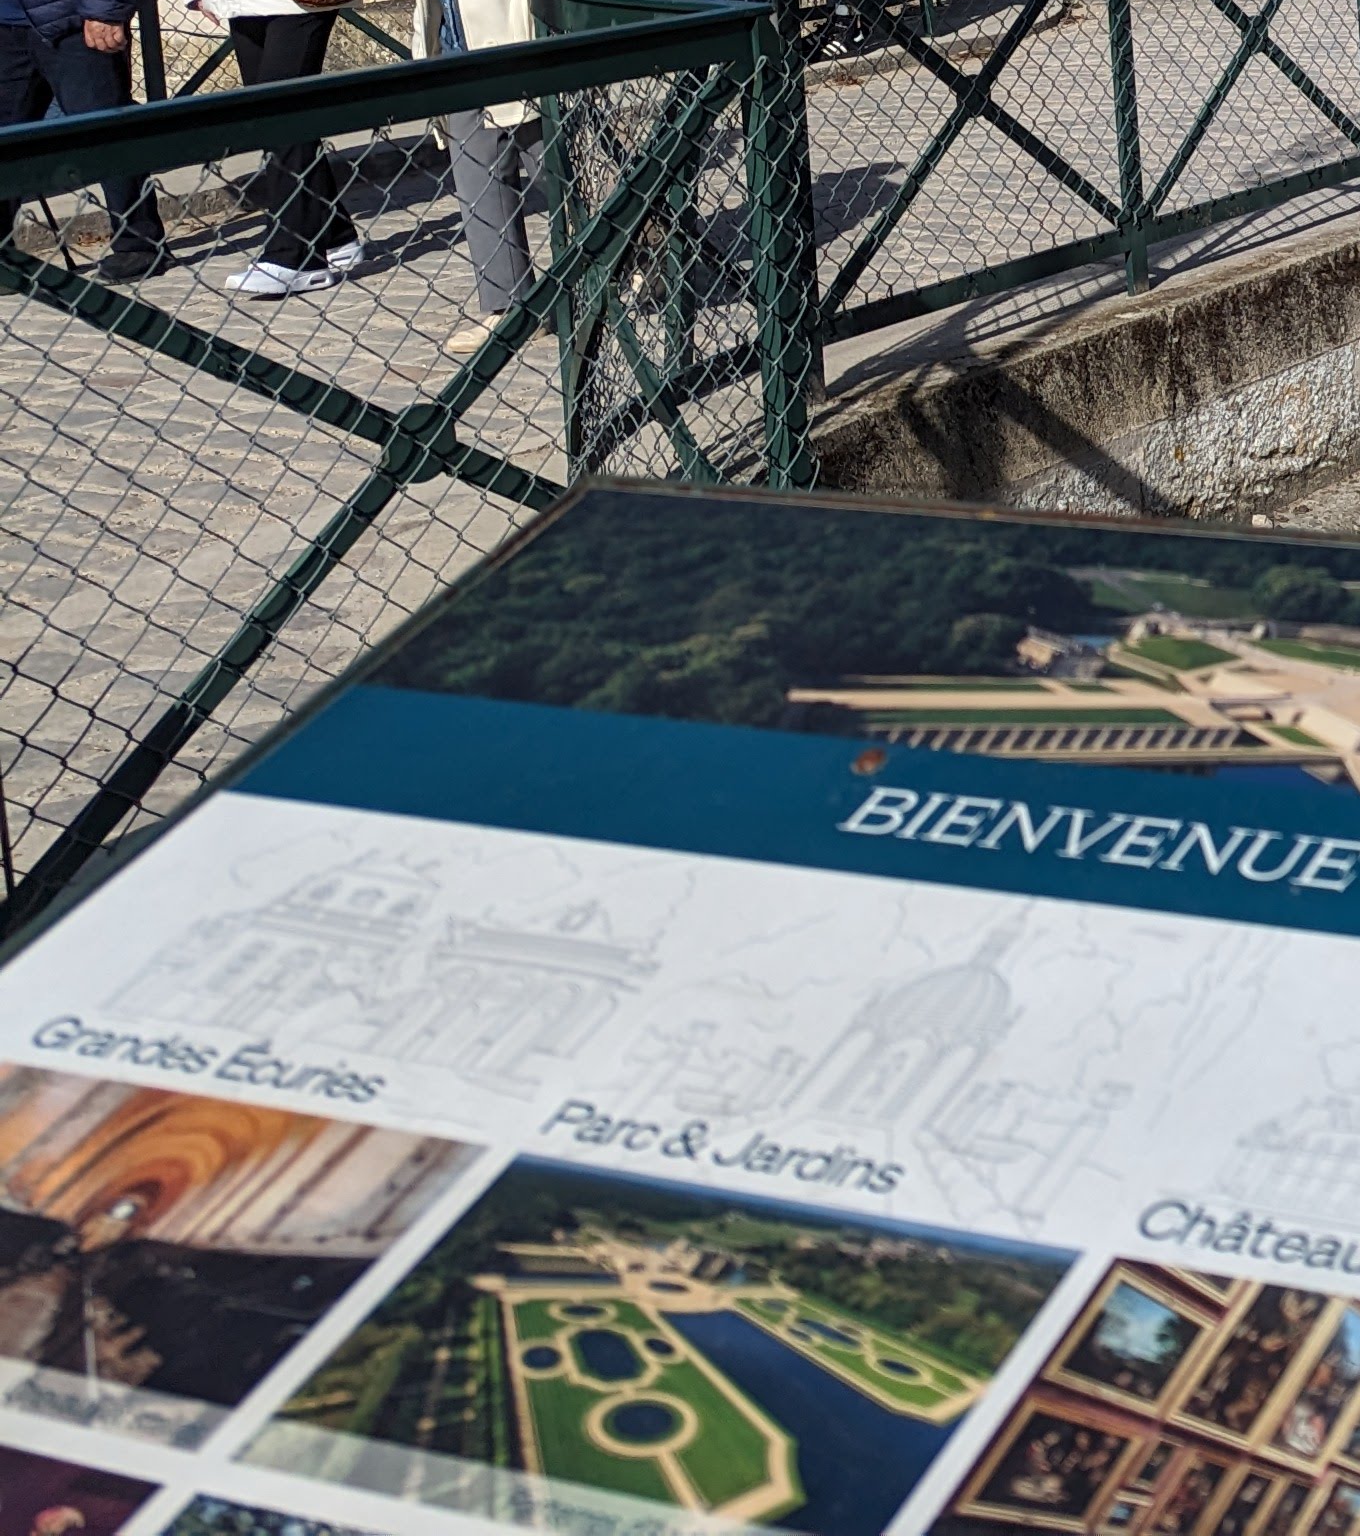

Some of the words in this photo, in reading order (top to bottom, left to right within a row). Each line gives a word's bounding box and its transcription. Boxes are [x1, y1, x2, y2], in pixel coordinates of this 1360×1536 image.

[32, 1014, 219, 1075] Grandes
[214, 1039, 388, 1104] Écuries
[540, 1098, 661, 1152] Parc
[661, 1119, 709, 1161] &
[712, 1131, 906, 1195] Jardins
